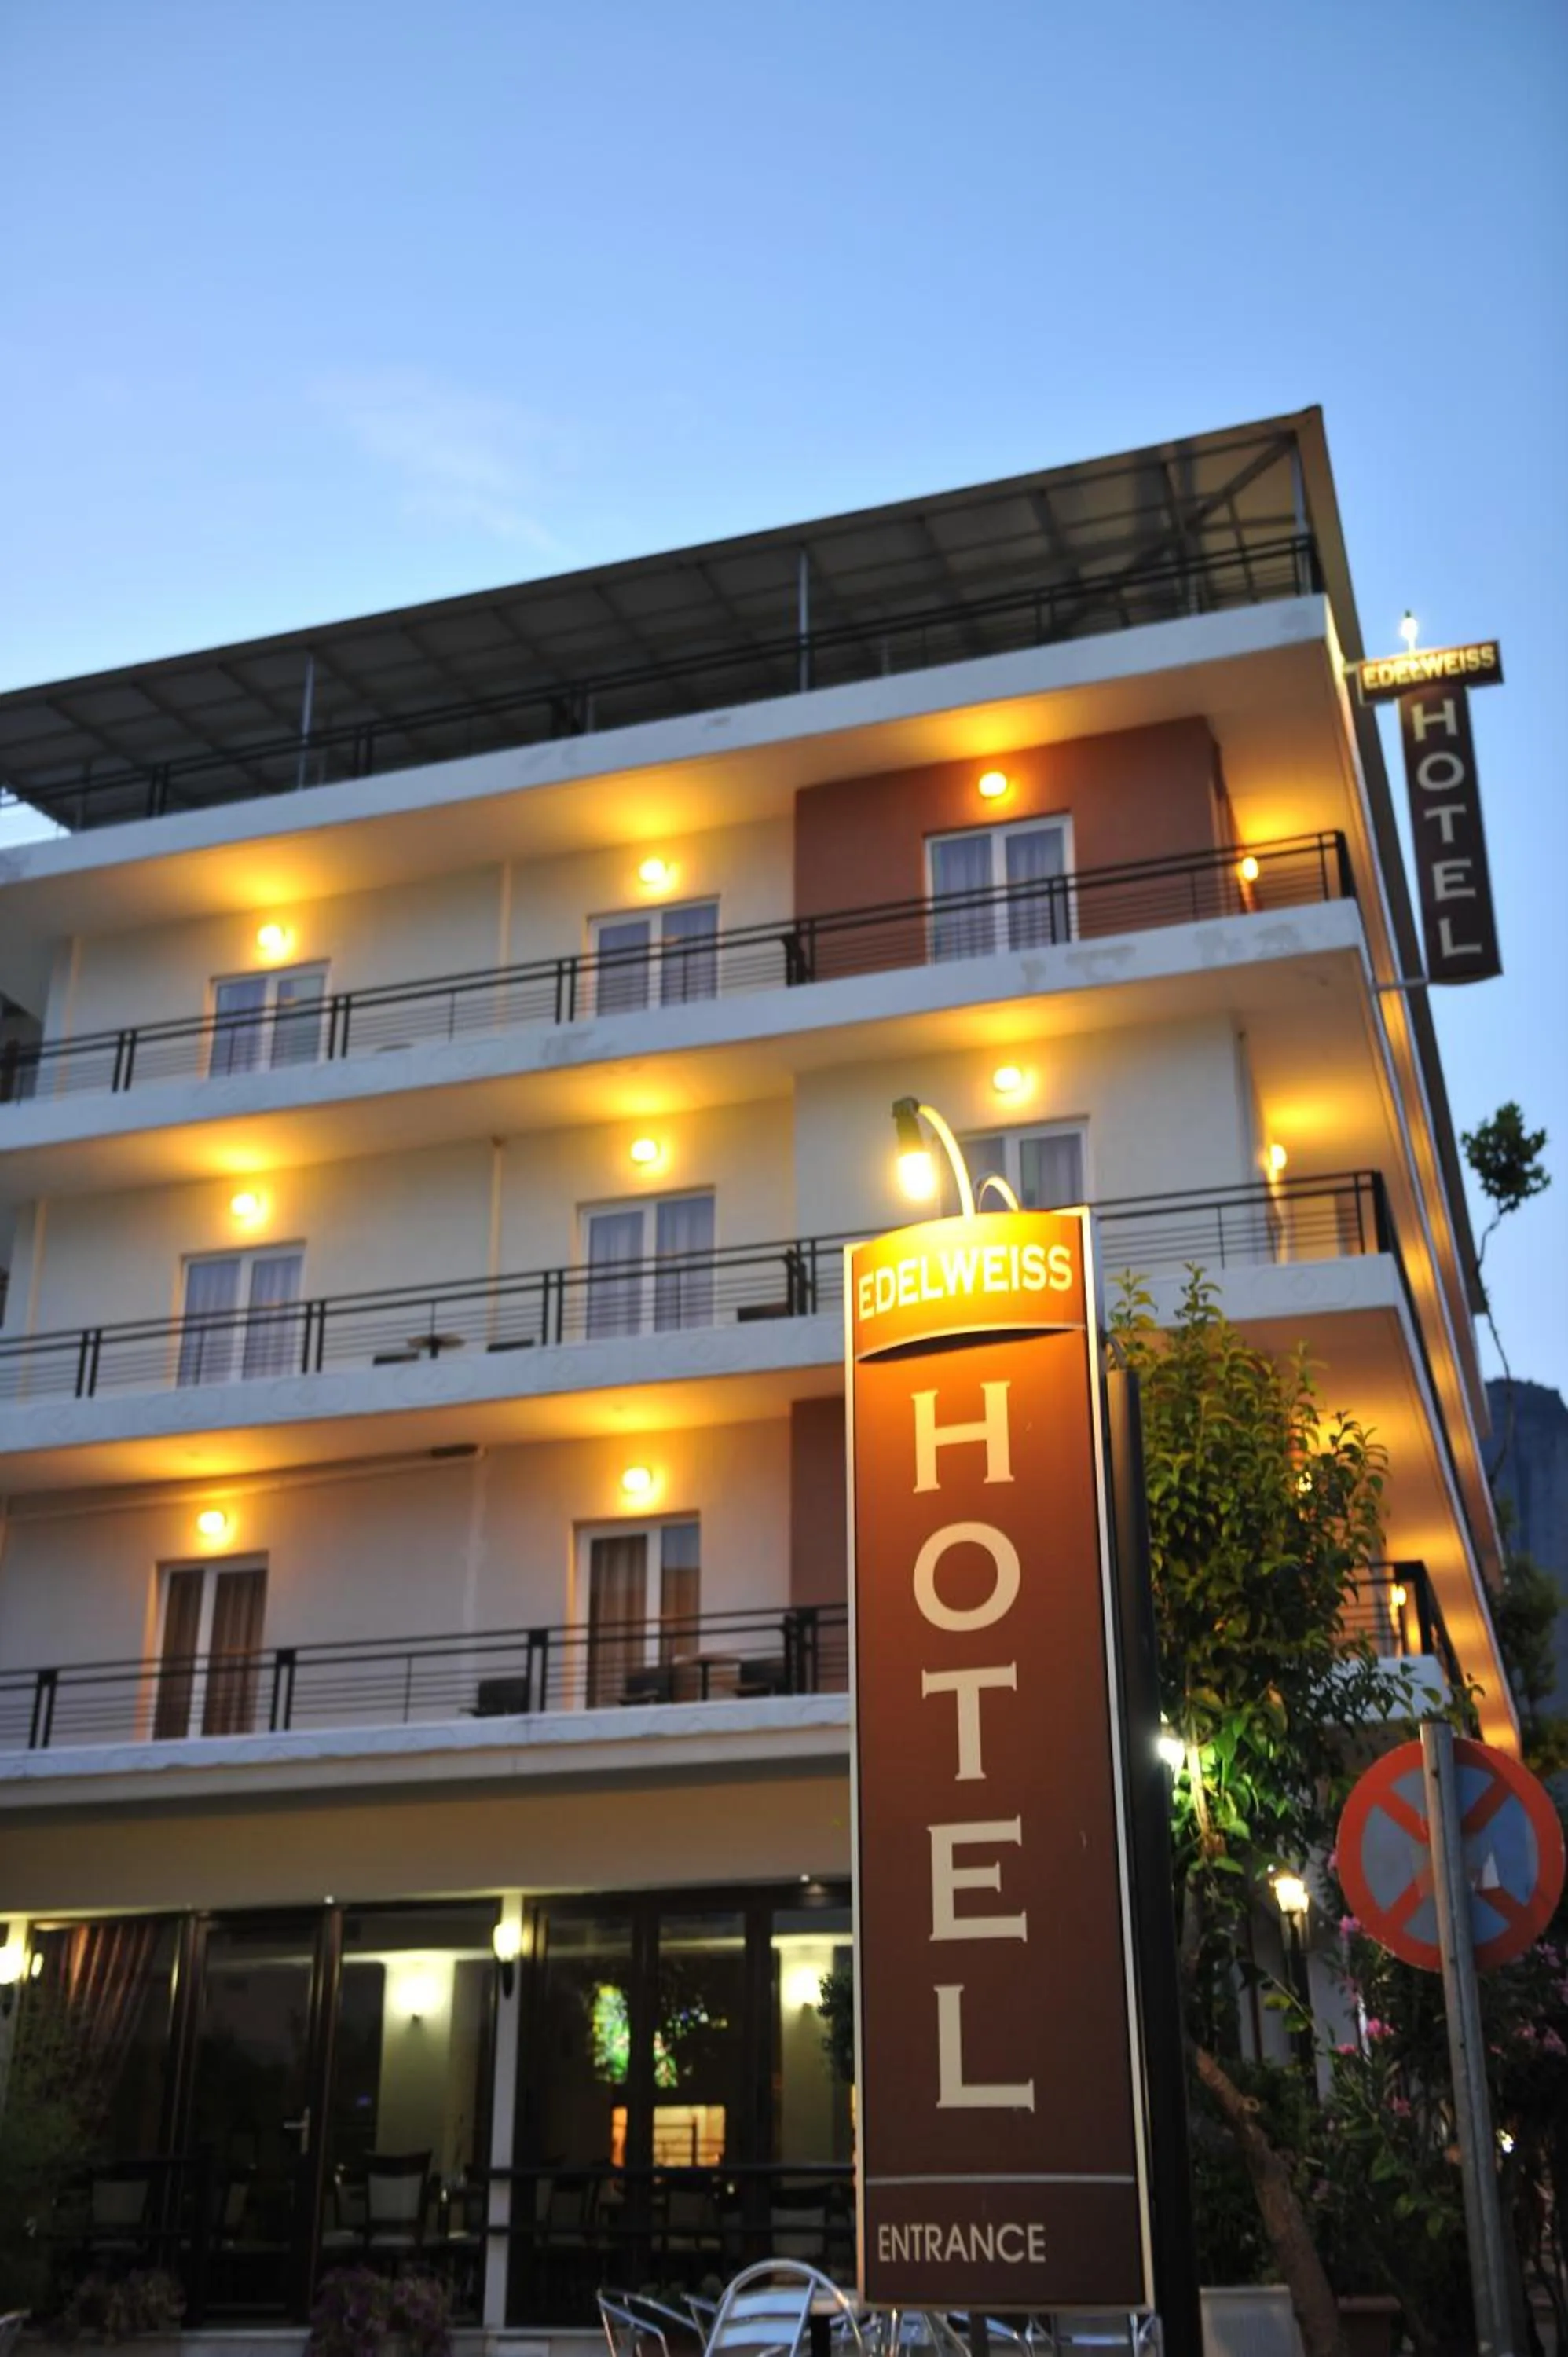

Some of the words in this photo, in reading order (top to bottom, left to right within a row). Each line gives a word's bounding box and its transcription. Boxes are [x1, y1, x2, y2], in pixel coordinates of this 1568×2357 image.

[1363, 645, 1496, 689] EDELWEISS
[1411, 698, 1482, 959] HOTEL
[858, 1244, 1072, 1321] EDELWEISS
[910, 1380, 1035, 2112] HOTEL
[878, 2223, 1046, 2263] ENTRANCE
